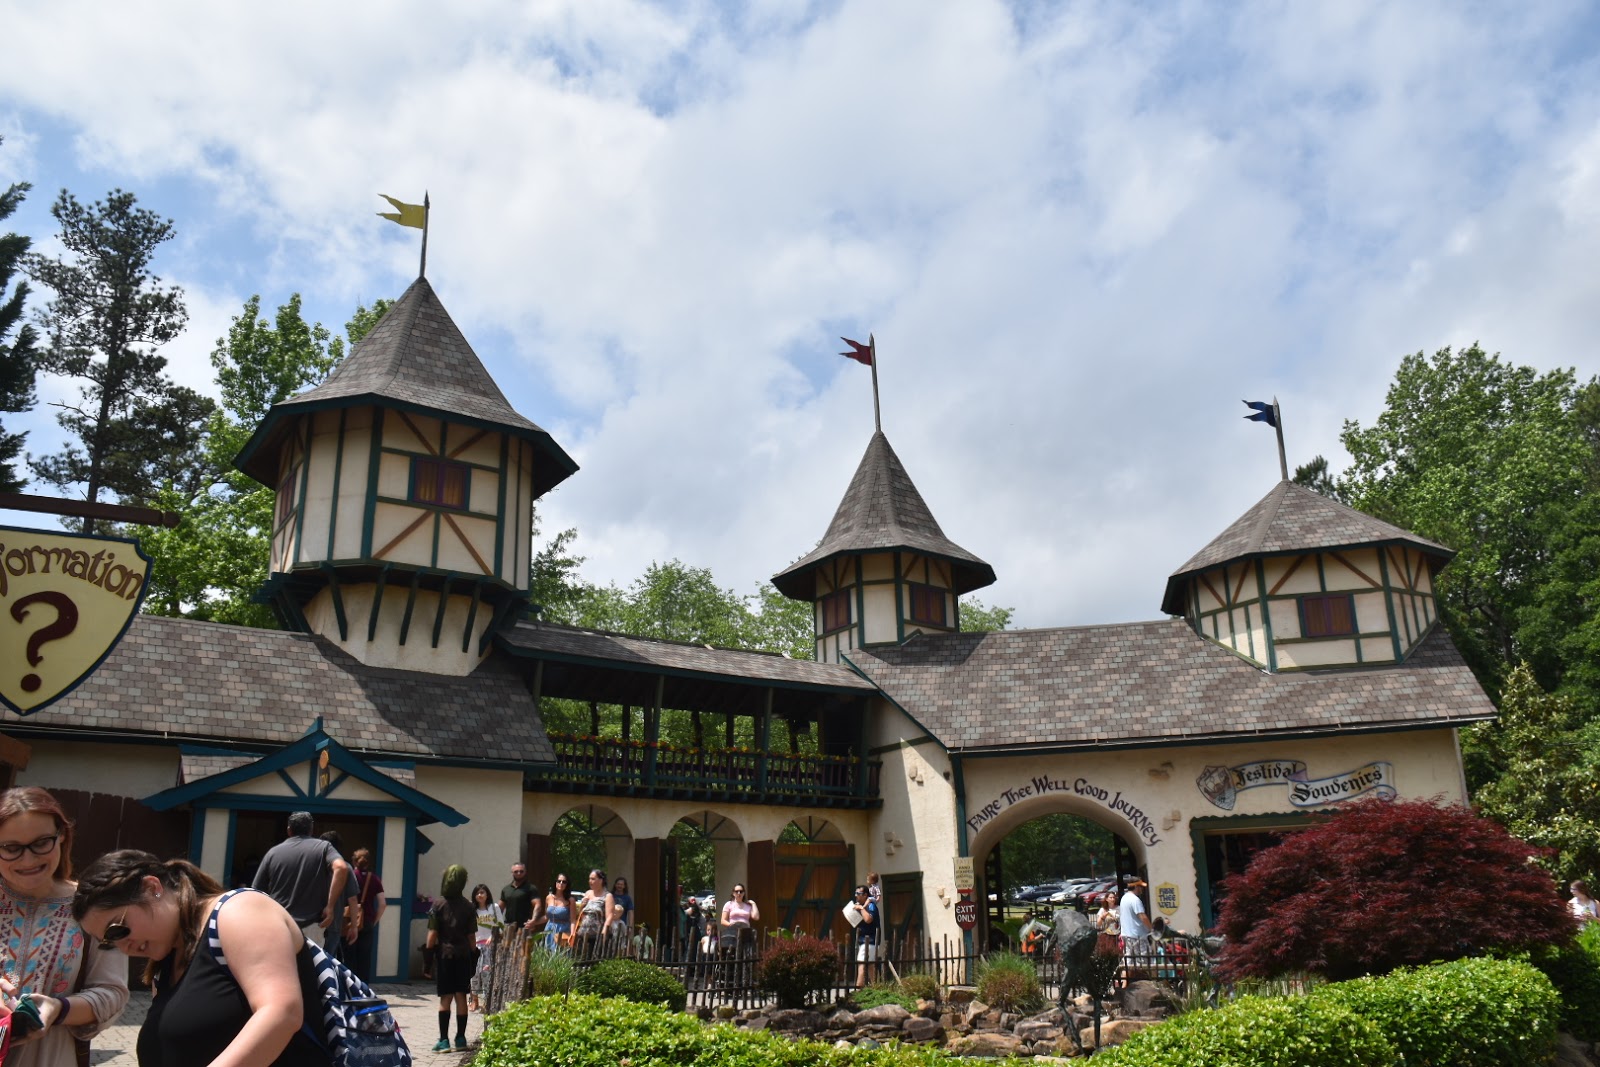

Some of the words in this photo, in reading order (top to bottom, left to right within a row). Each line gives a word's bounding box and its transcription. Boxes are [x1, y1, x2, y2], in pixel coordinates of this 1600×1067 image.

[1236, 762, 1298, 787] Festival
[1291, 766, 1382, 803] Souvenirs
[956, 905, 975, 914] EXIT
[957, 914, 975, 922] ONLY
